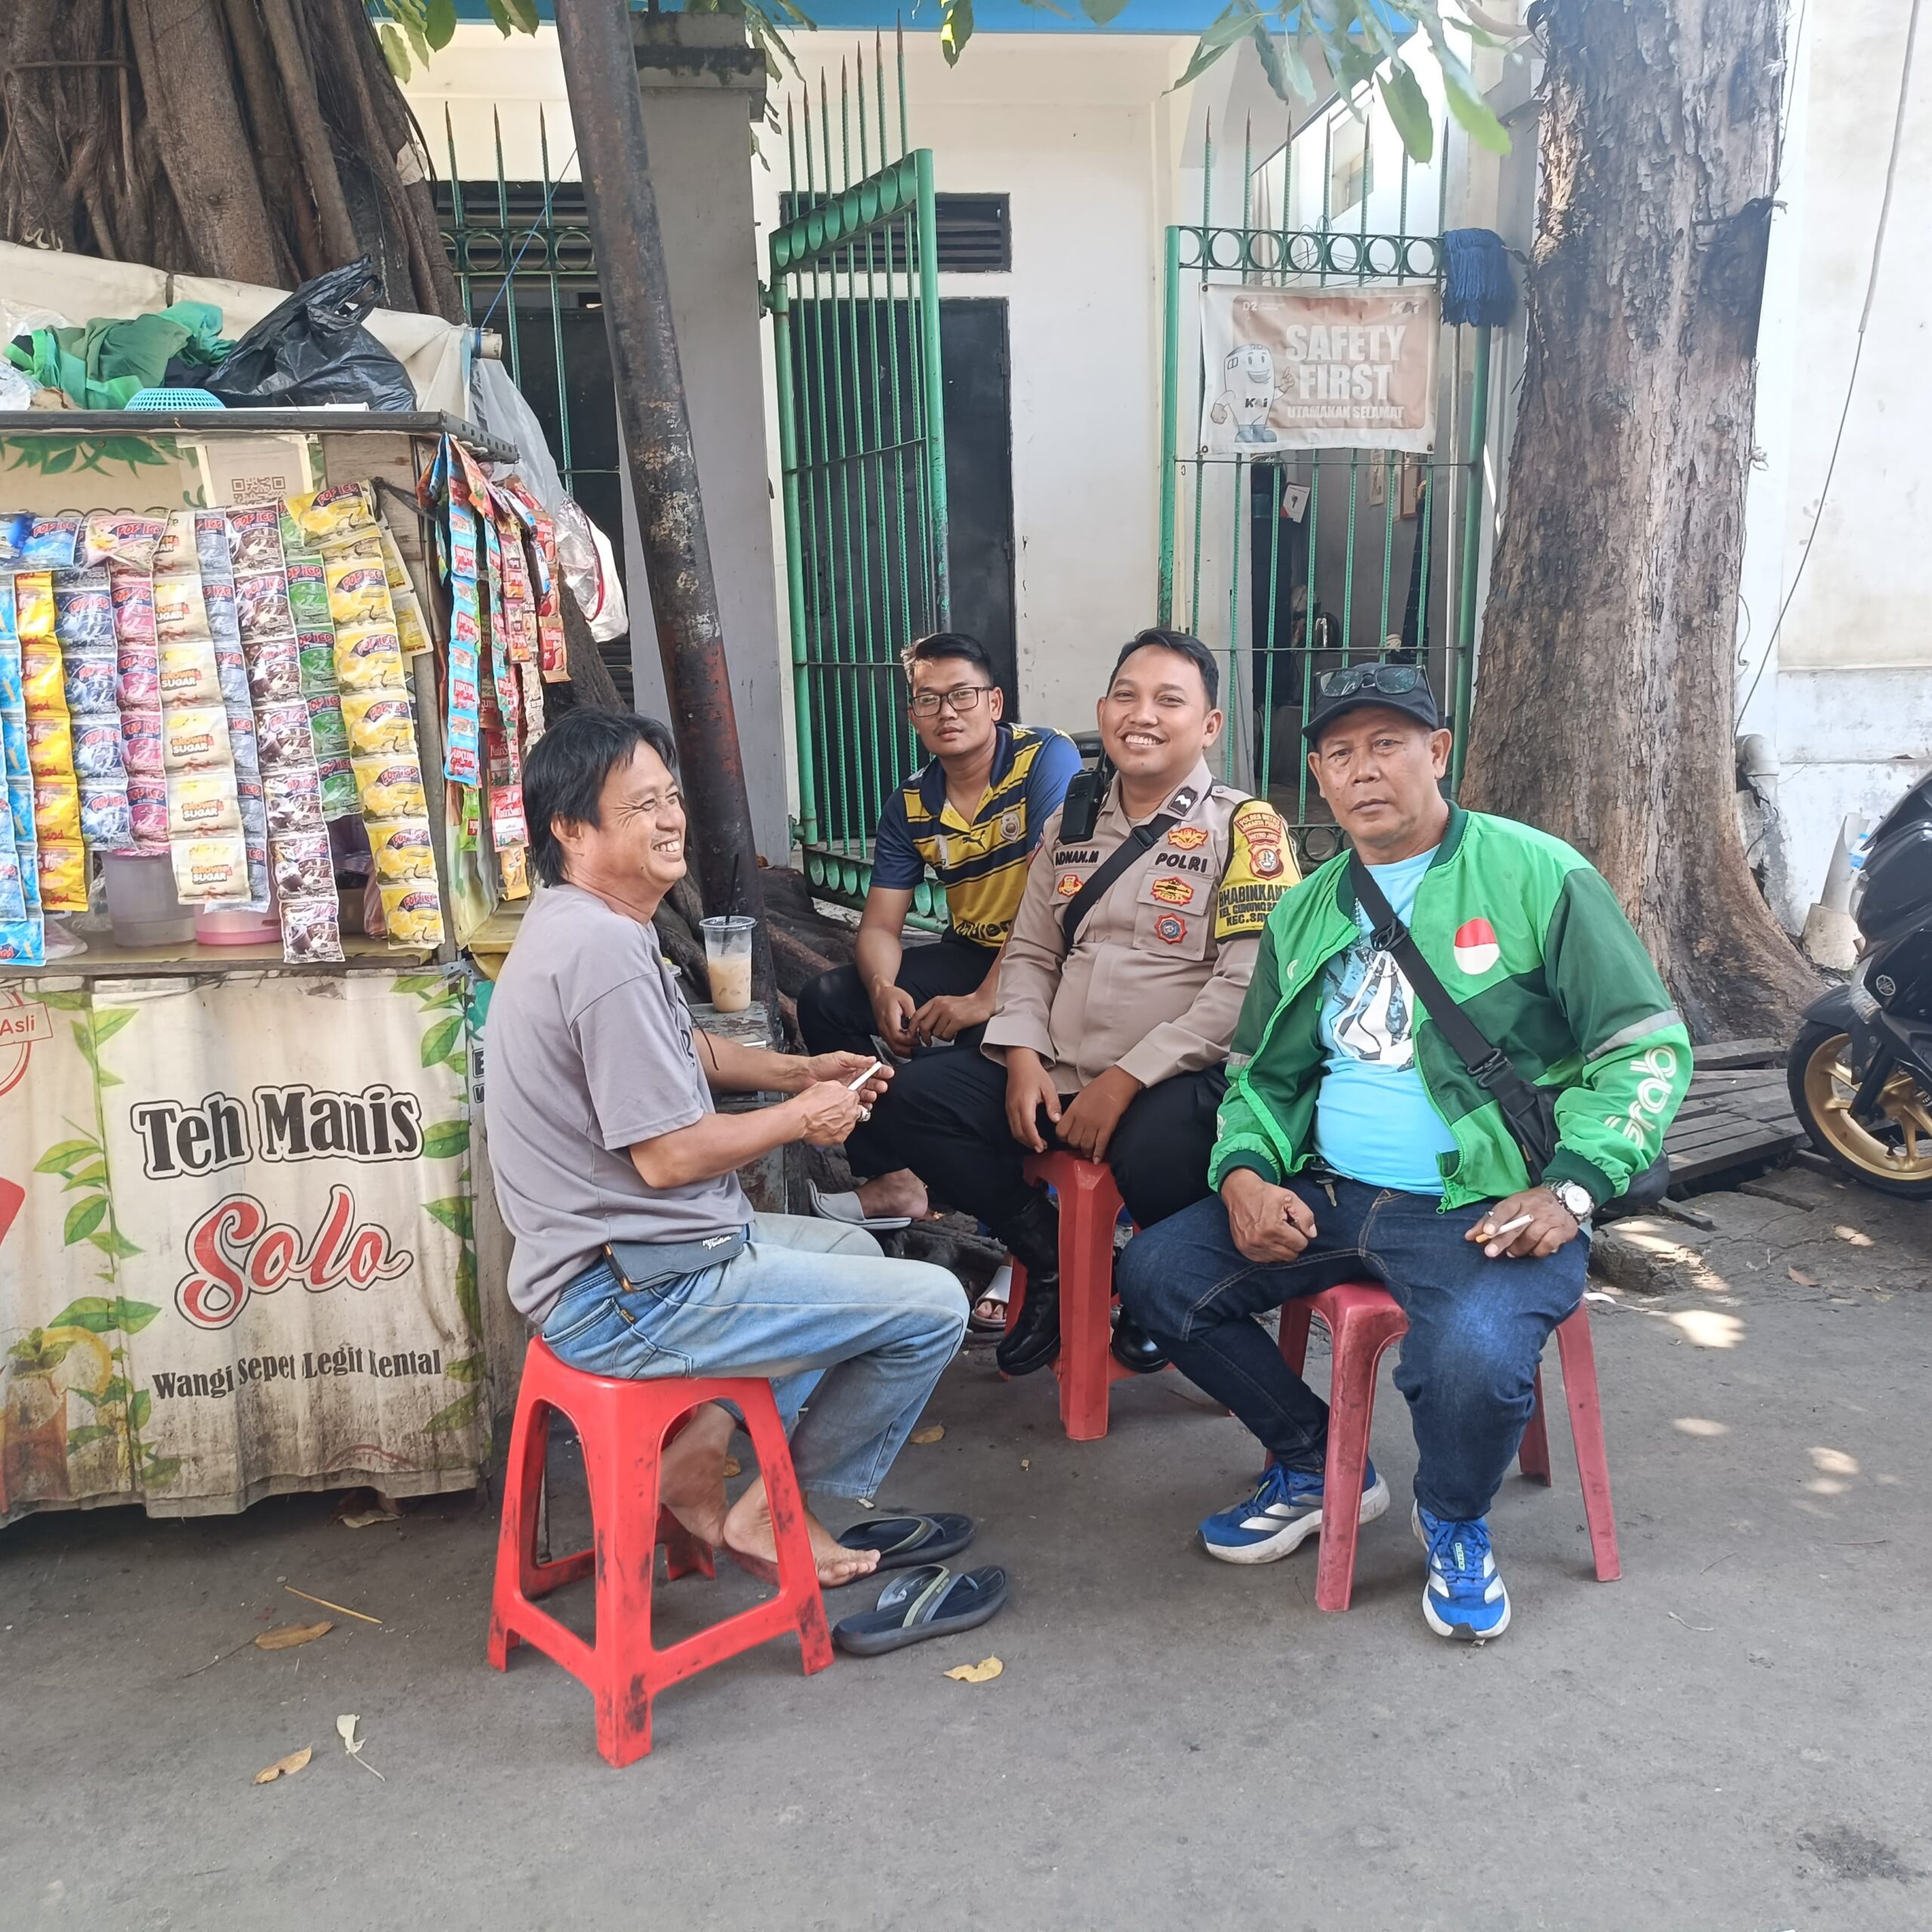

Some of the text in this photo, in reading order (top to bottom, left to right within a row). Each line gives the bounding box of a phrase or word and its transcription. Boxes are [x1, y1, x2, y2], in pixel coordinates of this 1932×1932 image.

[1285, 325, 1407, 361] SAFETY
[1299, 364, 1393, 400] FIRST
[1287, 405, 1404, 419] UTAMAKAN SELAMAT
[318, 483, 358, 505] POP ICE
[234, 512, 275, 528] POP ICE
[33, 522, 57, 537] POP
[117, 524, 141, 535] POP
[302, 566, 321, 577] ICE
[342, 572, 362, 589] POP
[157, 612, 183, 622] UGAR
[314, 633, 333, 643] ICE
[162, 678, 197, 689] SUGAR
[232, 721, 252, 731] ICE
[171, 734, 209, 746] BROWN
[172, 743, 209, 755] SUGAR
[242, 784, 261, 795] ICE
[183, 809, 218, 820] SUGAR
[1155, 853, 1208, 873] POLRI
[192, 872, 227, 883] SUGAR
[0, 1014, 35, 1036] Asli
[134, 1087, 422, 1177] Teh Manis
[177, 1186, 413, 1328] Solo
[152, 1365, 235, 1400] Wangi
[238, 1353, 297, 1386] Sepet
[303, 1346, 364, 1380] Legit
